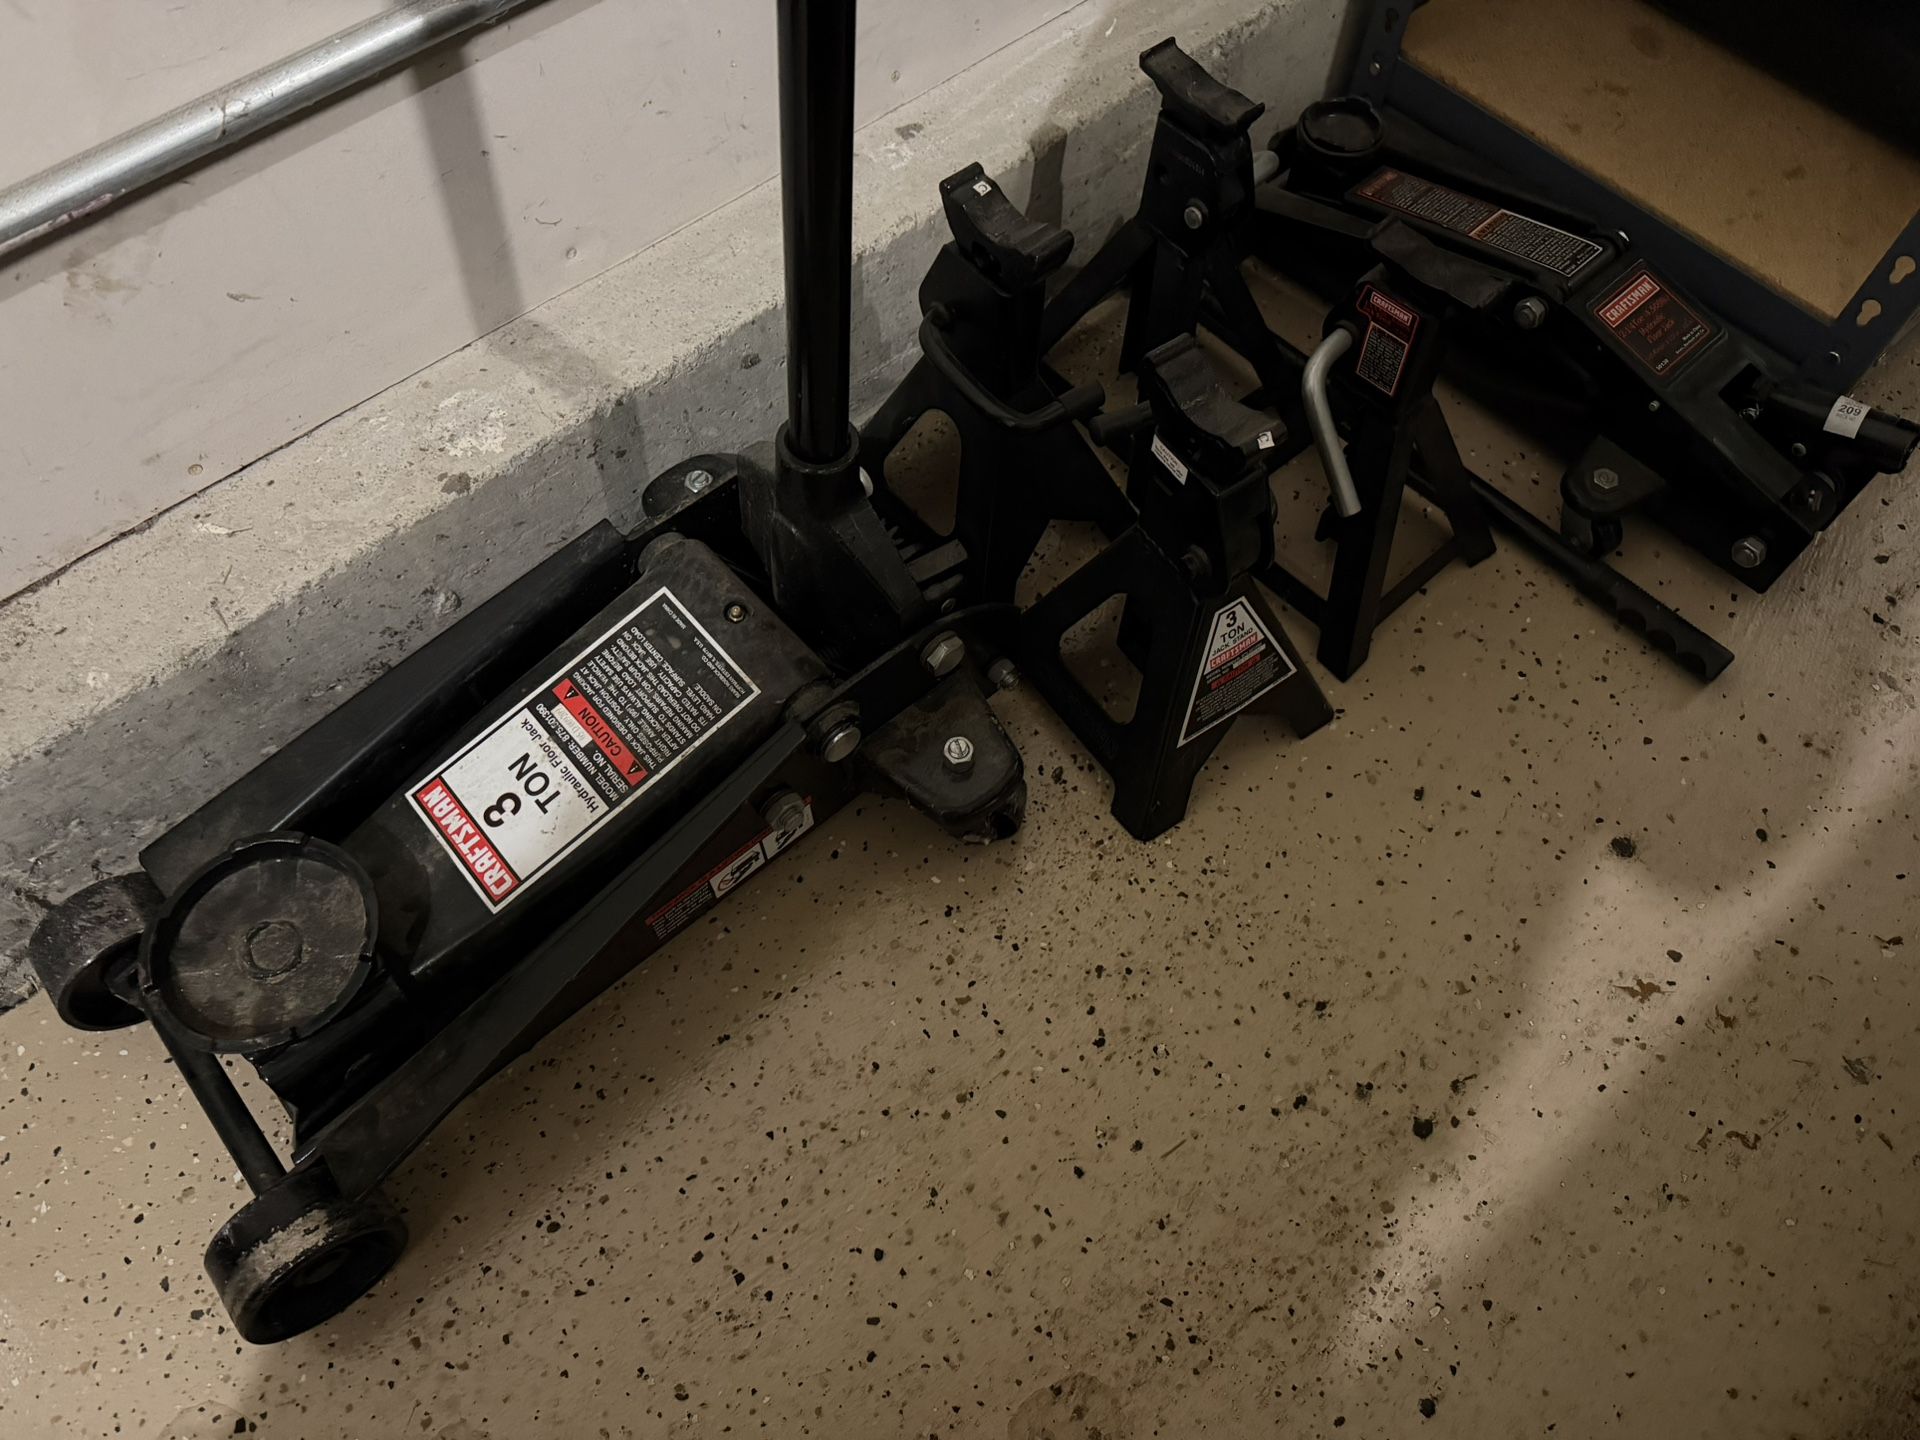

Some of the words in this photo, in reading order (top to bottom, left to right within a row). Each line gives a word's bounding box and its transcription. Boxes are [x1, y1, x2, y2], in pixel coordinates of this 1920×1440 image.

[1370, 296, 1410, 322] CRAFTSMAN
[1605, 281, 1652, 321] CRAFTSMAN
[1838, 404, 1861, 416] 209
[1226, 611, 1237, 627] 3
[621, 630, 632, 640] ON
[630, 626, 646, 642] LOAD
[1212, 642, 1230, 656] JACK
[1233, 627, 1253, 643] STAND
[1220, 622, 1245, 643] TON
[616, 637, 637, 660] BEYOND
[631, 640, 646, 656] JACK
[643, 640, 663, 662] CENTER
[1211, 635, 1257, 667] CRAFTSMAN
[593, 654, 614, 676] SAFETY
[601, 648, 623, 671] BEFORE
[633, 658, 649, 672] JACK
[644, 656, 657, 669] USE
[579, 666, 589, 674] AT
[586, 659, 608, 684] VEHICLE
[621, 671, 637, 687] LOAD
[627, 664, 643, 682] YOUR
[646, 671, 659, 686] THIS
[572, 671, 595, 695] JACKING
[586, 673, 602, 689] JACK
[606, 683, 619, 696] THE
[610, 673, 623, 687] USE
[640, 679, 654, 693] FOR
[657, 669, 682, 697] CAPACITY.
[592, 694, 605, 708] FOR
[598, 688, 623, 715] POSITION
[617, 696, 627, 706] TO
[620, 685, 642, 707] ALWAYS
[634, 687, 659, 713] SUPPORT
[656, 683, 683, 712] OVERLOAD
[685, 686, 701, 704] LEVEL
[681, 697, 699, 716] RATED
[699, 701, 715, 720] HARD,
[711, 703, 722, 714] ON
[602, 706, 628, 735] DESIGNED
[623, 715, 639, 733] ONLY.
[636, 717, 656, 737] ANGLE
[657, 713, 667, 723] TO
[672, 715, 693, 738] MAKING
[680, 711, 693, 724] NOT
[690, 722, 701, 732] DO
[697, 715, 708, 726] ITS
[521, 718, 541, 740] Jack
[577, 707, 621, 756] CAUTION
[624, 733, 633, 741] IS
[664, 721, 686, 744] STANDS
[629, 738, 646, 754] JACK
[636, 730, 664, 763] PURPOSES
[653, 738, 671, 757] RIGHT
[660, 731, 679, 750] AFTER
[538, 741, 562, 768] Floor
[567, 739, 597, 775] NUMBER:
[592, 749, 606, 767] NO.
[642, 754, 656, 769] THIS
[507, 752, 560, 814] TON
[594, 772, 619, 801] MODEL
[603, 763, 628, 793] SERIAL
[560, 766, 599, 813] Hydraulic
[483, 792, 521, 827] 3
[422, 785, 512, 894] CRAFTSMAN
